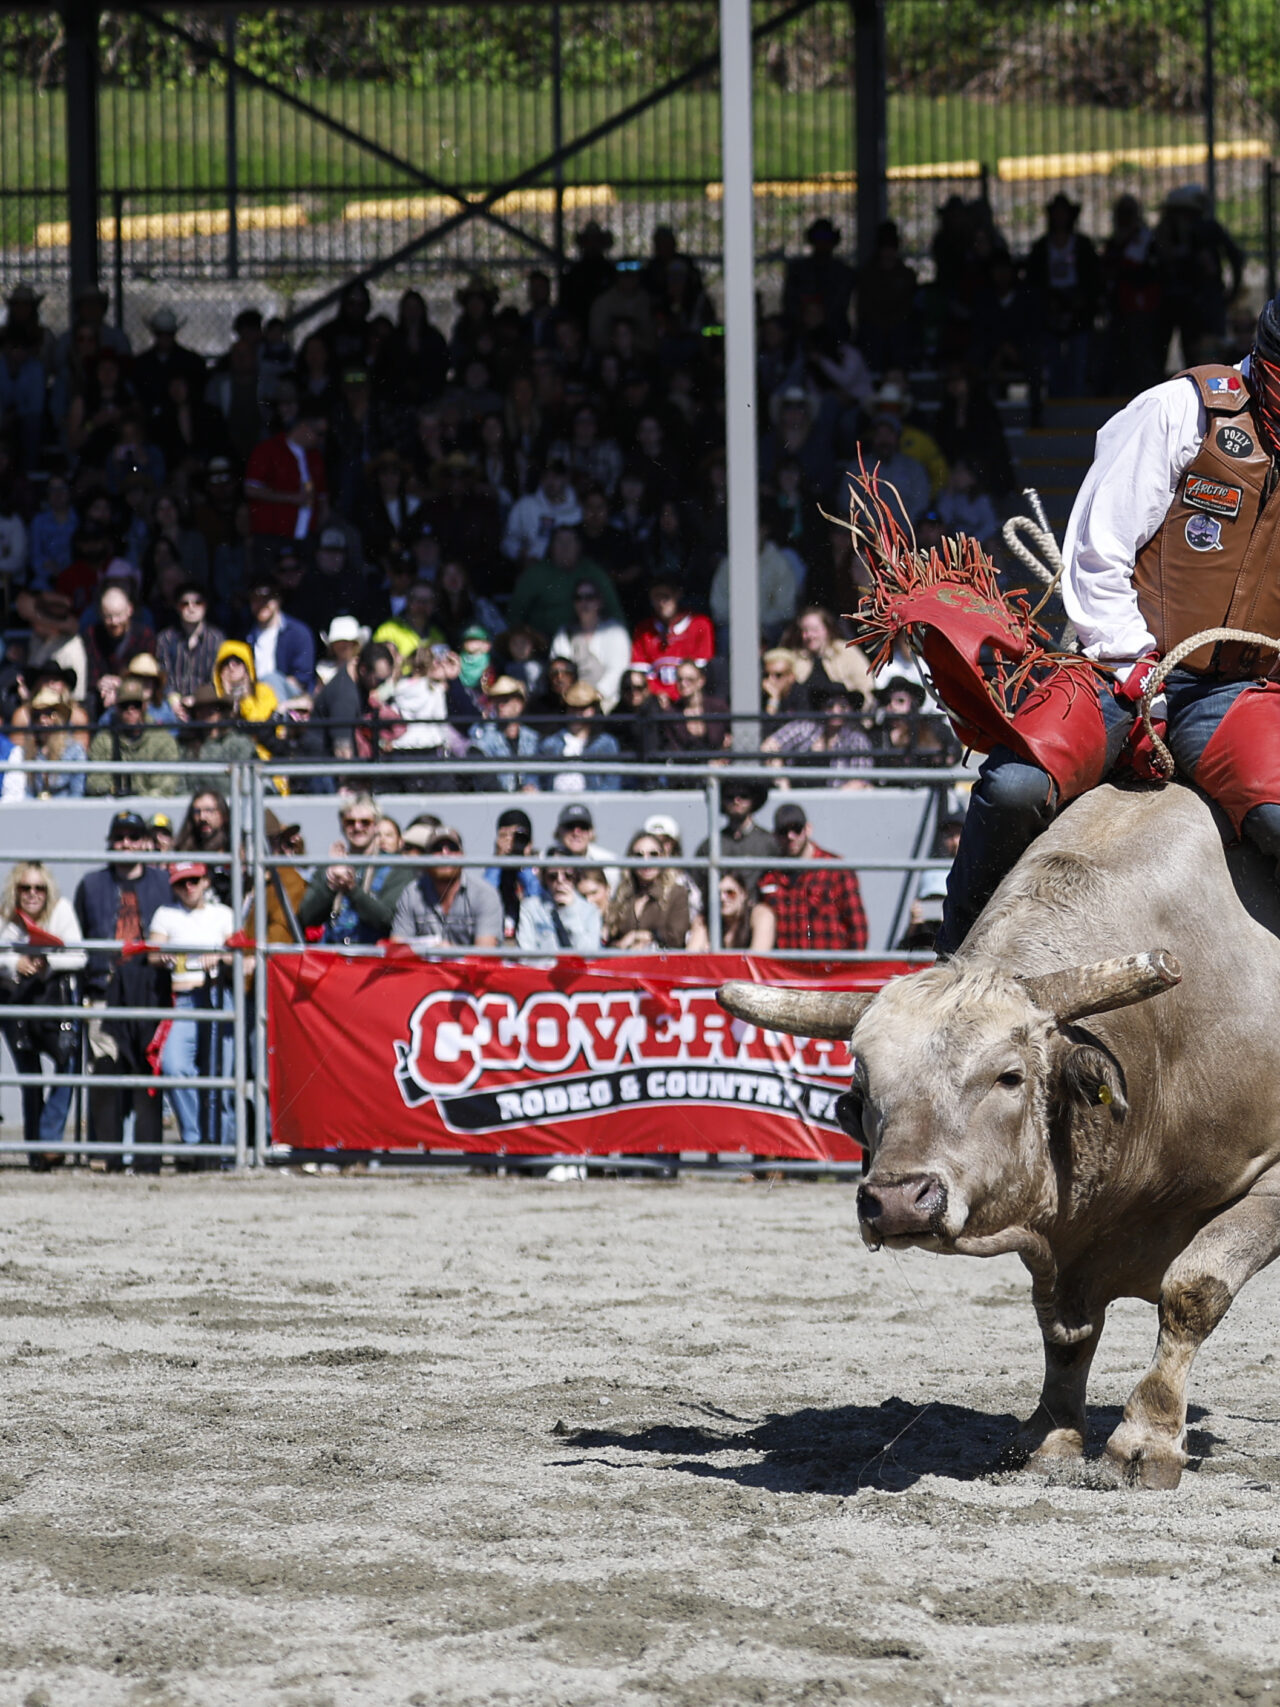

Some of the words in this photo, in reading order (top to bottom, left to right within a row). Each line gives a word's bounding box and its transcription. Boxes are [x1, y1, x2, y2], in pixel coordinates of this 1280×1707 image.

[1223, 428, 1251, 447] POZZY
[1224, 440, 1240, 454] 23
[1187, 479, 1229, 497] ARCTIC
[495, 1079, 613, 1121] RODEO
[619, 1074, 641, 1101] &
[646, 1070, 804, 1109] COUNTRY
